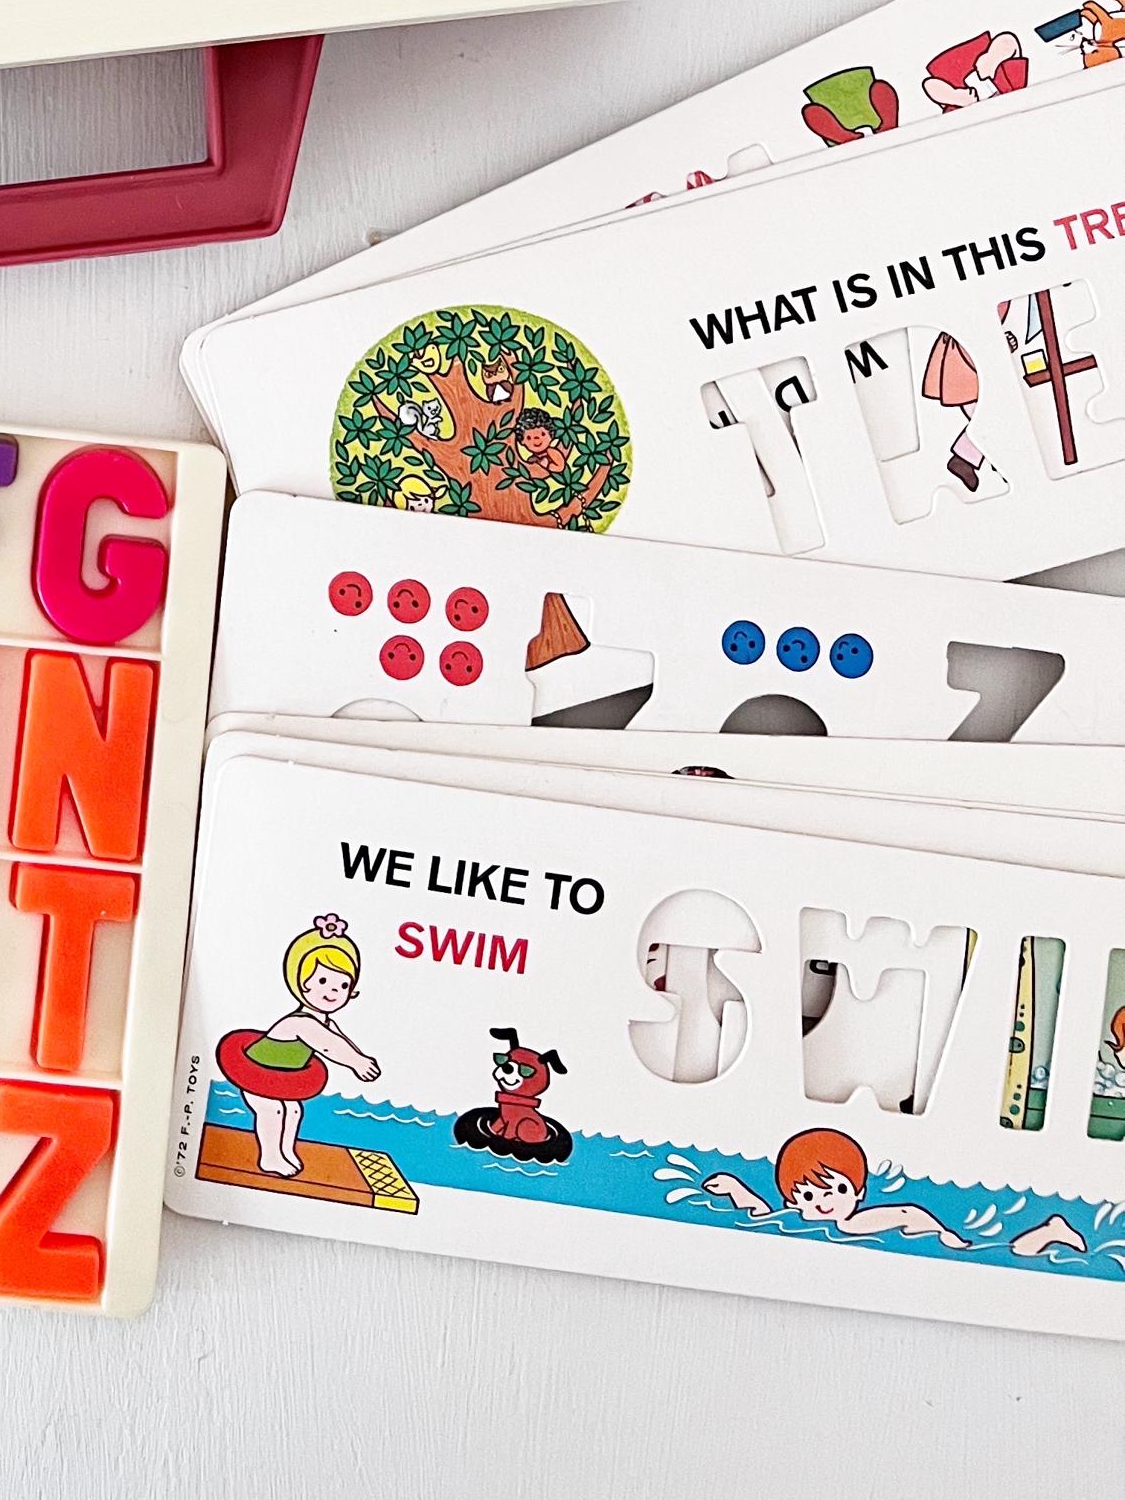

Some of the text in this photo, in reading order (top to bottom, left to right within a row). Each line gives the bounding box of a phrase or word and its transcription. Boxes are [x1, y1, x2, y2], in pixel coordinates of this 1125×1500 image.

[689, 286, 818, 350] WHAT
[832, 273, 878, 313] IS
[887, 256, 936, 298] IN
[941, 227, 1046, 281] THIS
[30, 445, 170, 649] G
[8, 649, 161, 867] N
[340, 842, 605, 915] WE LIKE TO
[7, 864, 138, 1076] T
[394, 921, 529, 974] SWIM
[187, 1055, 200, 1094] TOYS
